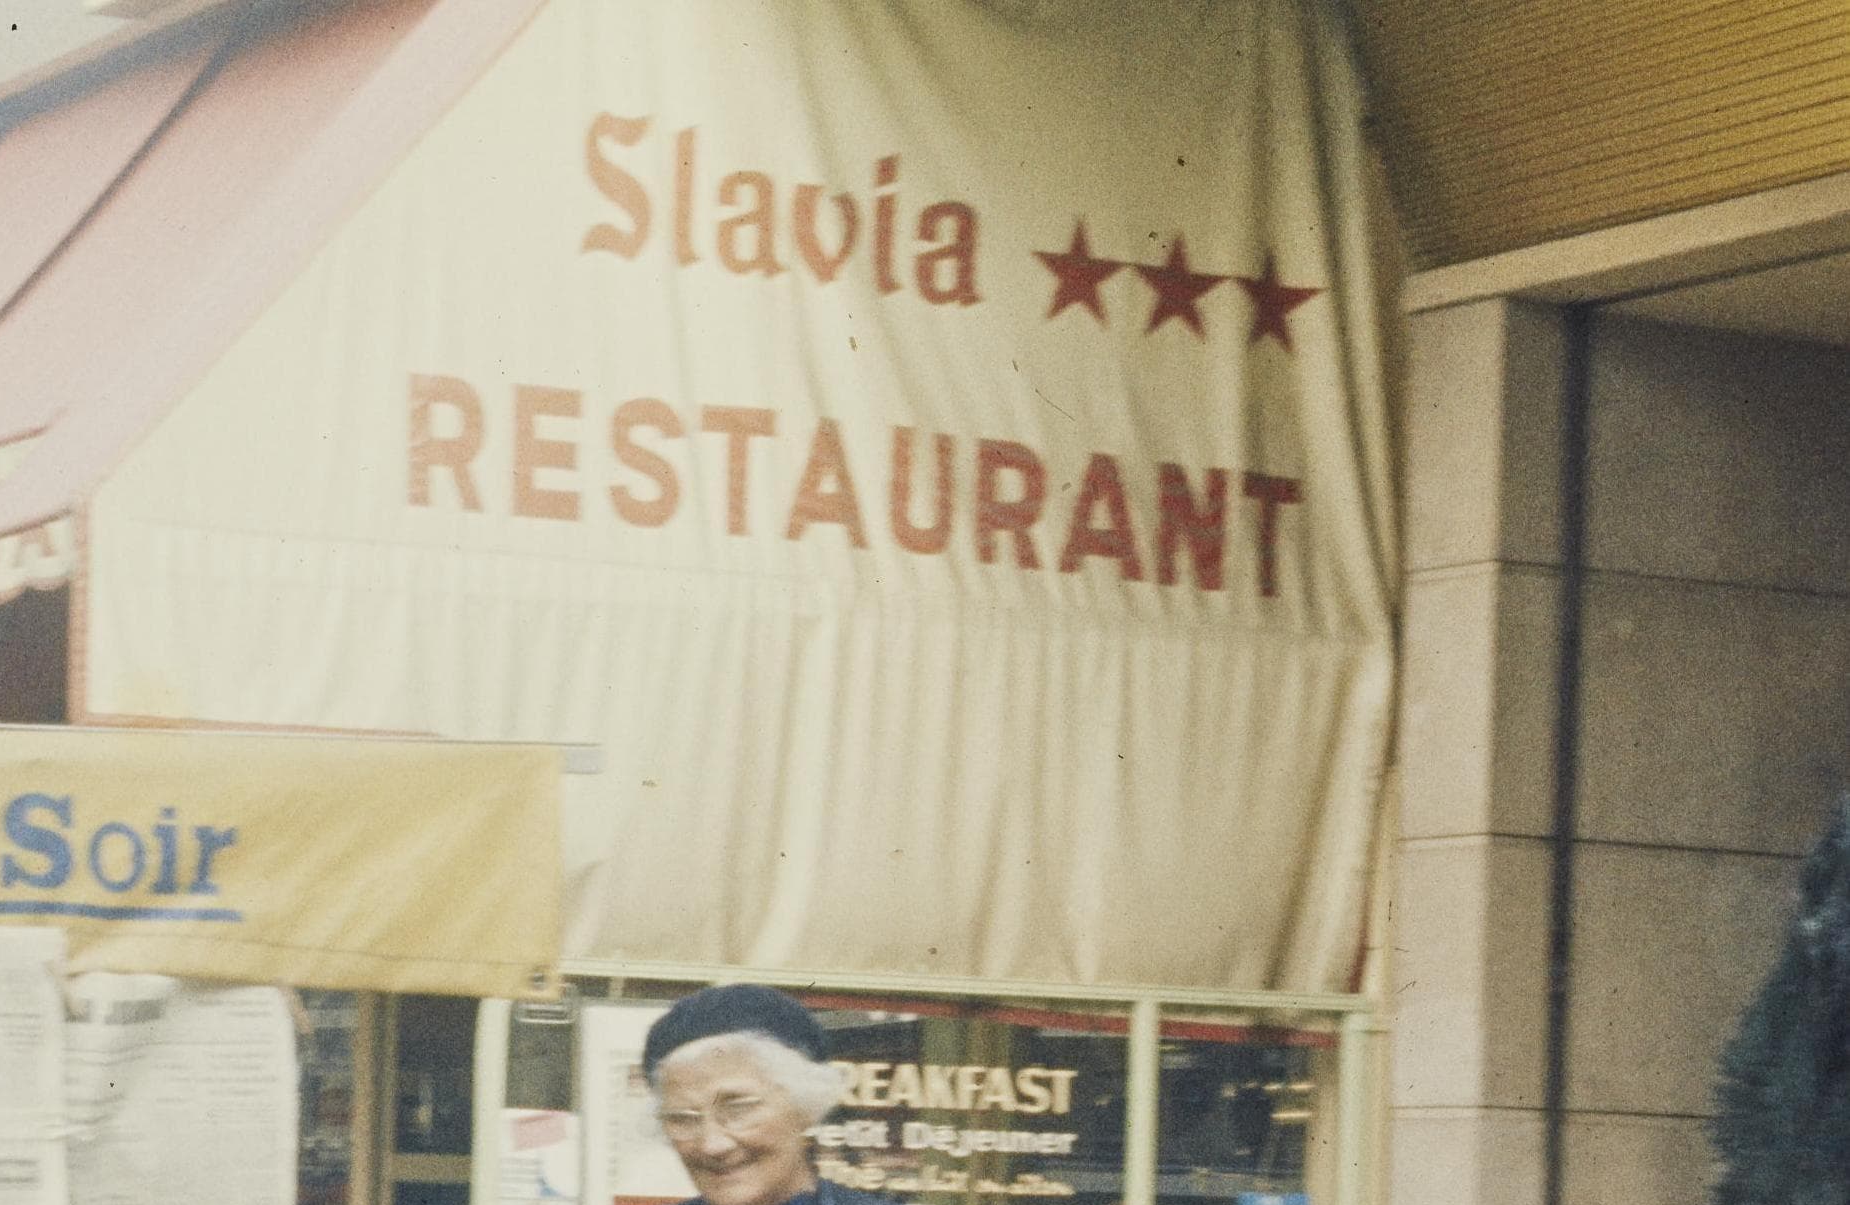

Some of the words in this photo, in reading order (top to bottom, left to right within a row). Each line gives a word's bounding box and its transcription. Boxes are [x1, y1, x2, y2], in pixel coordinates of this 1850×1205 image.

[579, 111, 984, 308] Slavia
[405, 371, 1304, 599] RESTAURANT
[1, 794, 236, 894] Soir
[828, 1060, 1078, 1115] REAKFAST
